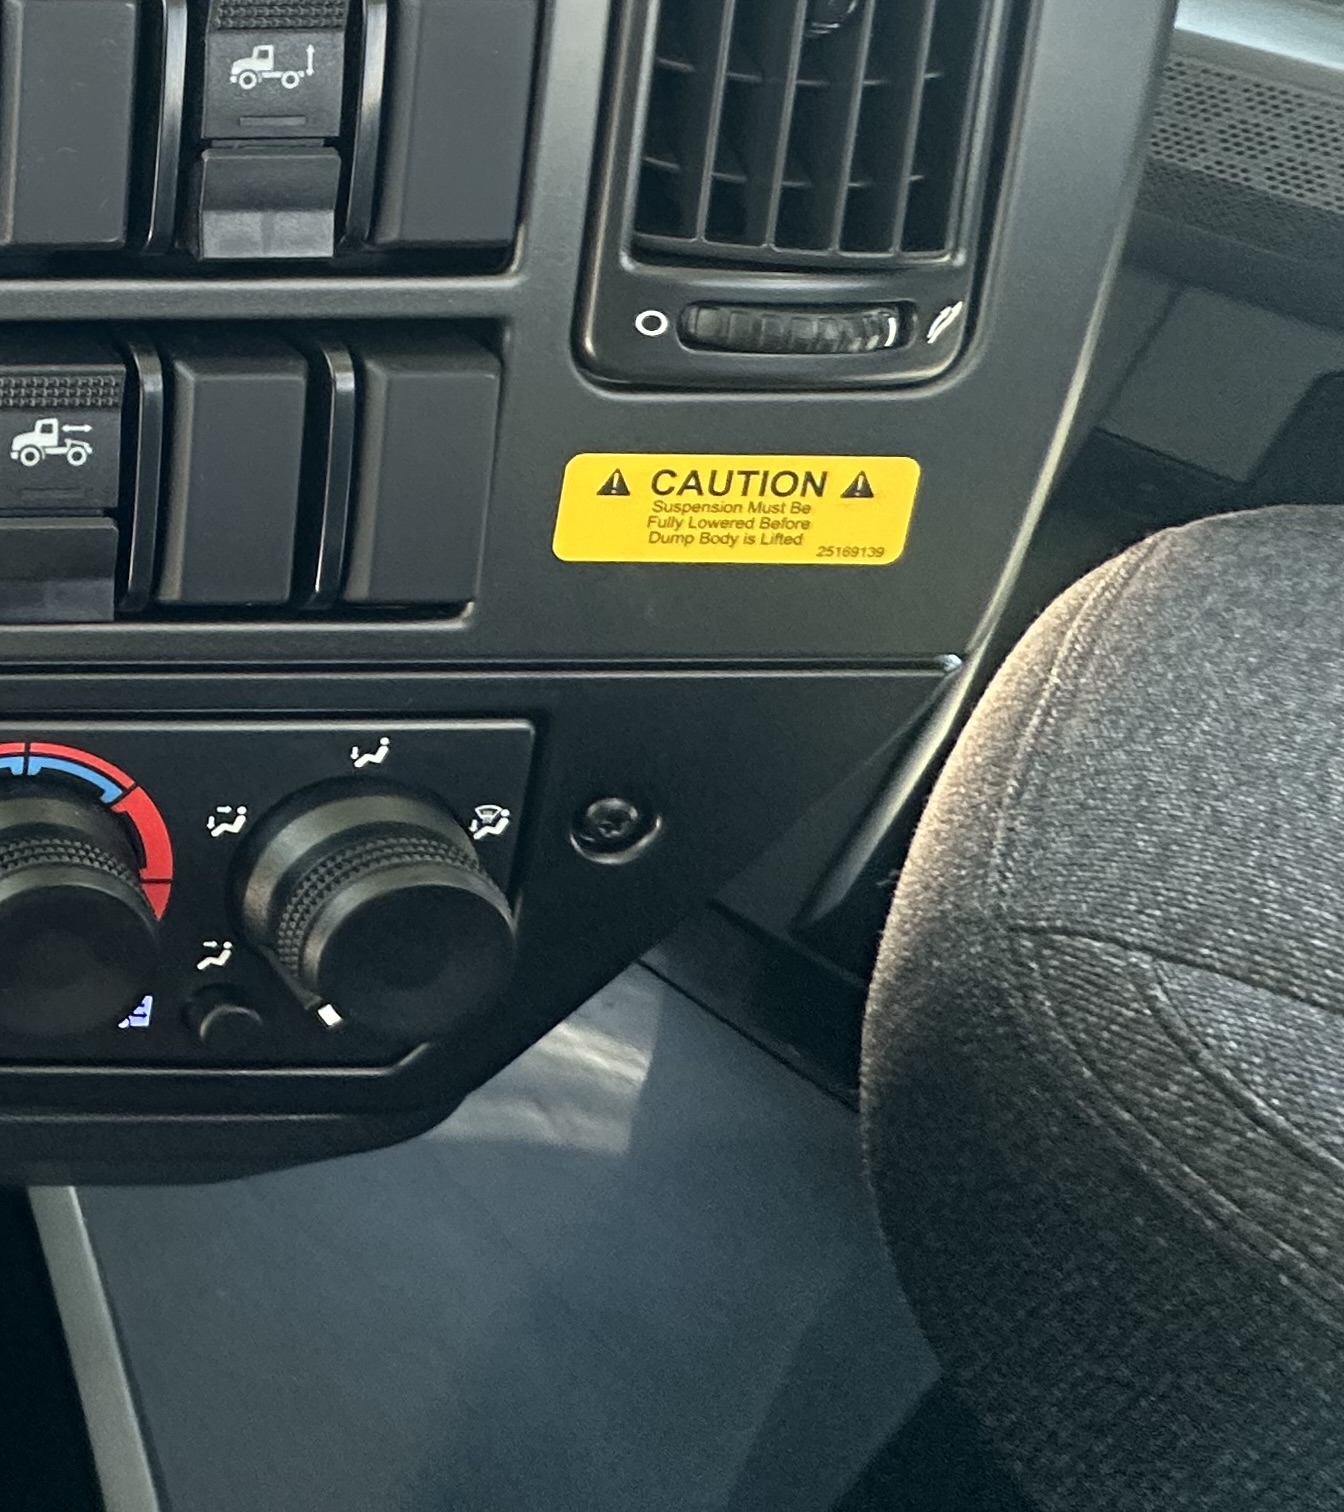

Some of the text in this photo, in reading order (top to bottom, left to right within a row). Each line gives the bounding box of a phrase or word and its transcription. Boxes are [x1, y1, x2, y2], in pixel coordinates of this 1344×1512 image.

[651, 469, 828, 498] CAUTION
[652, 500, 812, 515] Suspension Must Be
[647, 516, 811, 531] Fully Lowered Before
[648, 531, 803, 547] Dump Body is Lifted
